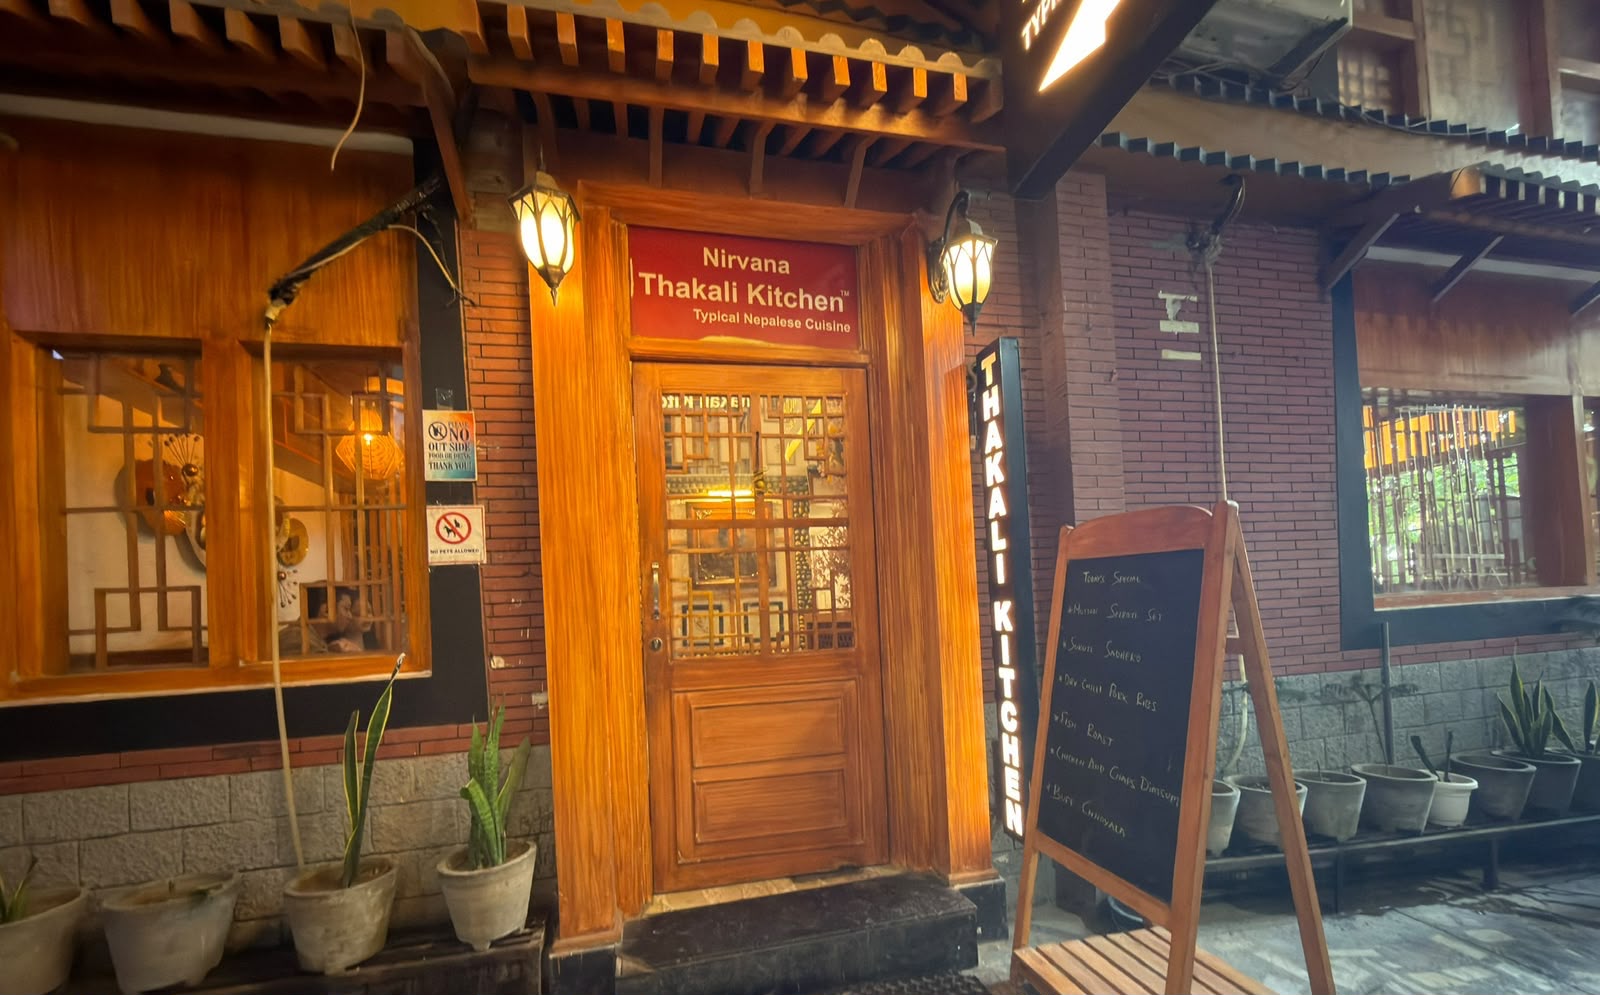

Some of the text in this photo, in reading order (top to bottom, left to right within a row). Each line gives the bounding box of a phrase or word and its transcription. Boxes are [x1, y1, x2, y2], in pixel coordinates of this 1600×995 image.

[703, 247, 790, 274] Nirvana
[638, 272, 738, 303] Thakali
[747, 283, 844, 313] Kitchen
[693, 308, 851, 333] Typical Nepalese Cuisine
[428, 442, 471, 452] OUT SIDE
[449, 428, 470, 441] NO
[428, 461, 453, 470] THANK
[981, 351, 1023, 837] THAKALI KITCHEN
